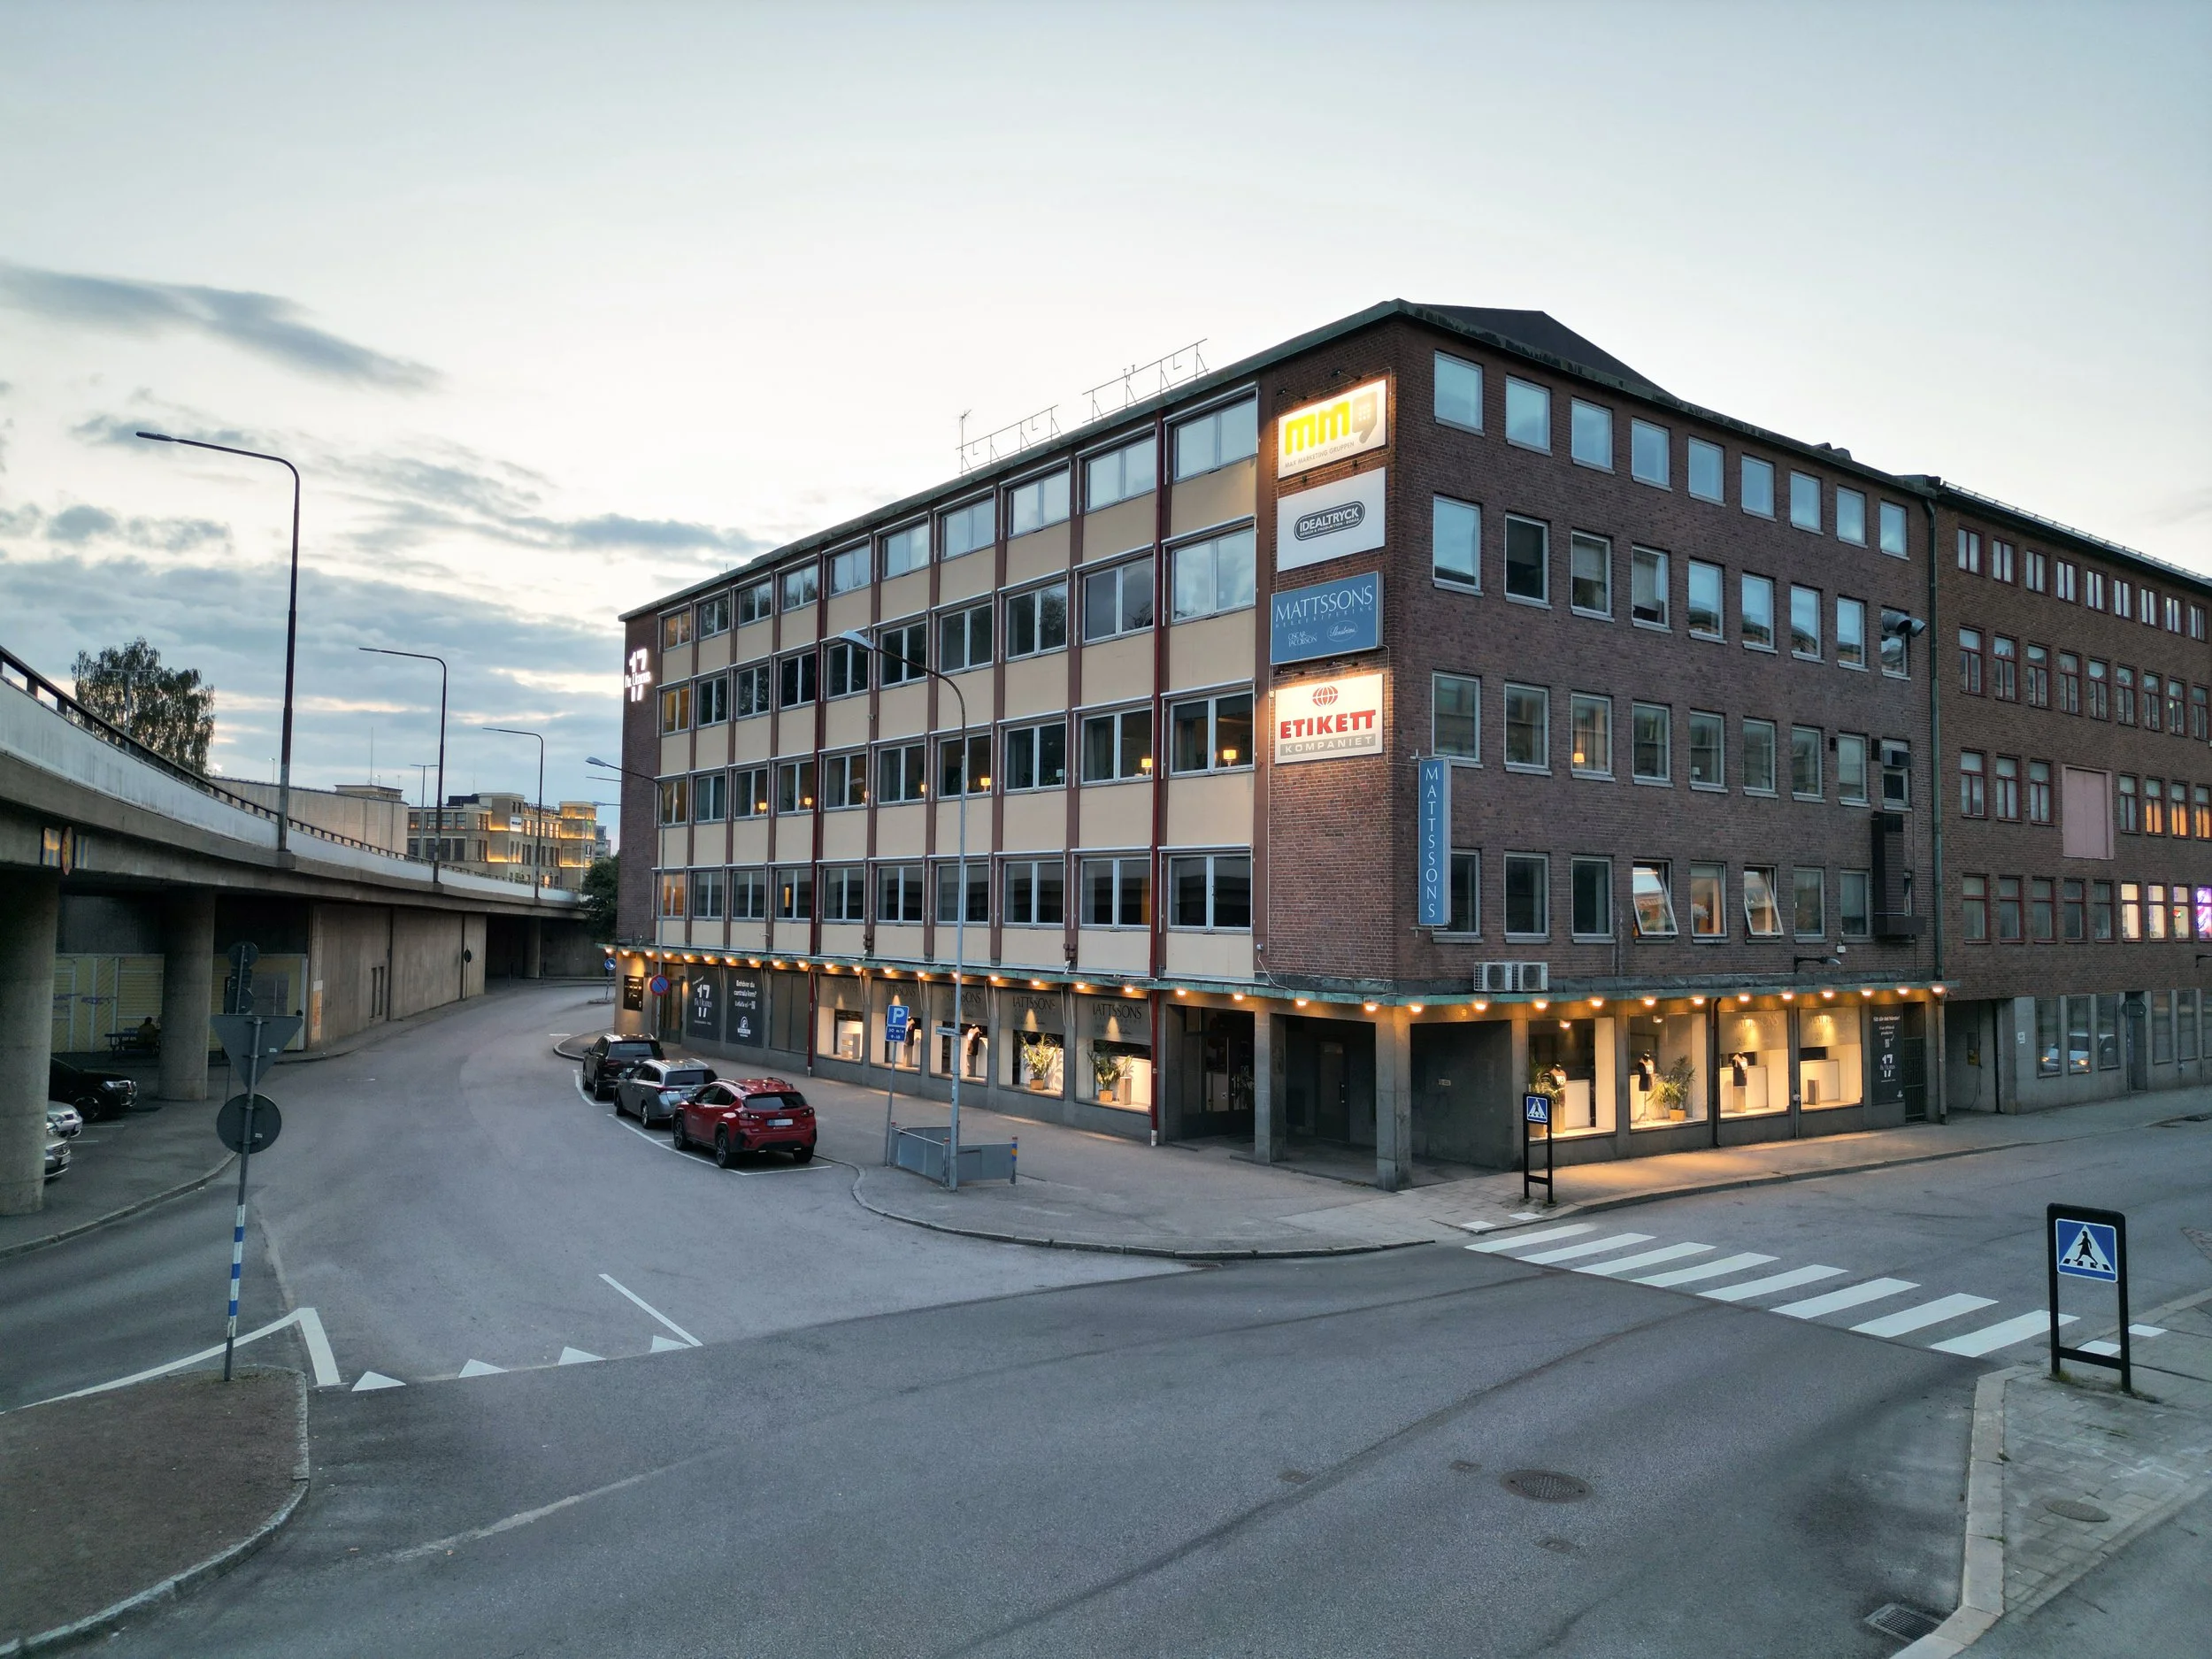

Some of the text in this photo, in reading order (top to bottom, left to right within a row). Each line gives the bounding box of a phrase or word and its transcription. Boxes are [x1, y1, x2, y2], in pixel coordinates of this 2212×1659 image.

[1285, 441, 1355, 468] MAX MARKETING GRUPPEN
[1299, 506, 1360, 533] IDEALTRYCK
[1275, 585, 1373, 623] MATTSSONS
[1287, 631, 1308, 641] OSCAR
[1280, 709, 1377, 740] ETIKETT
[1285, 735, 1373, 754] KOMPANIET
[1425, 766, 1439, 918] MATTSSONS
[892, 1007, 905, 1024] P
